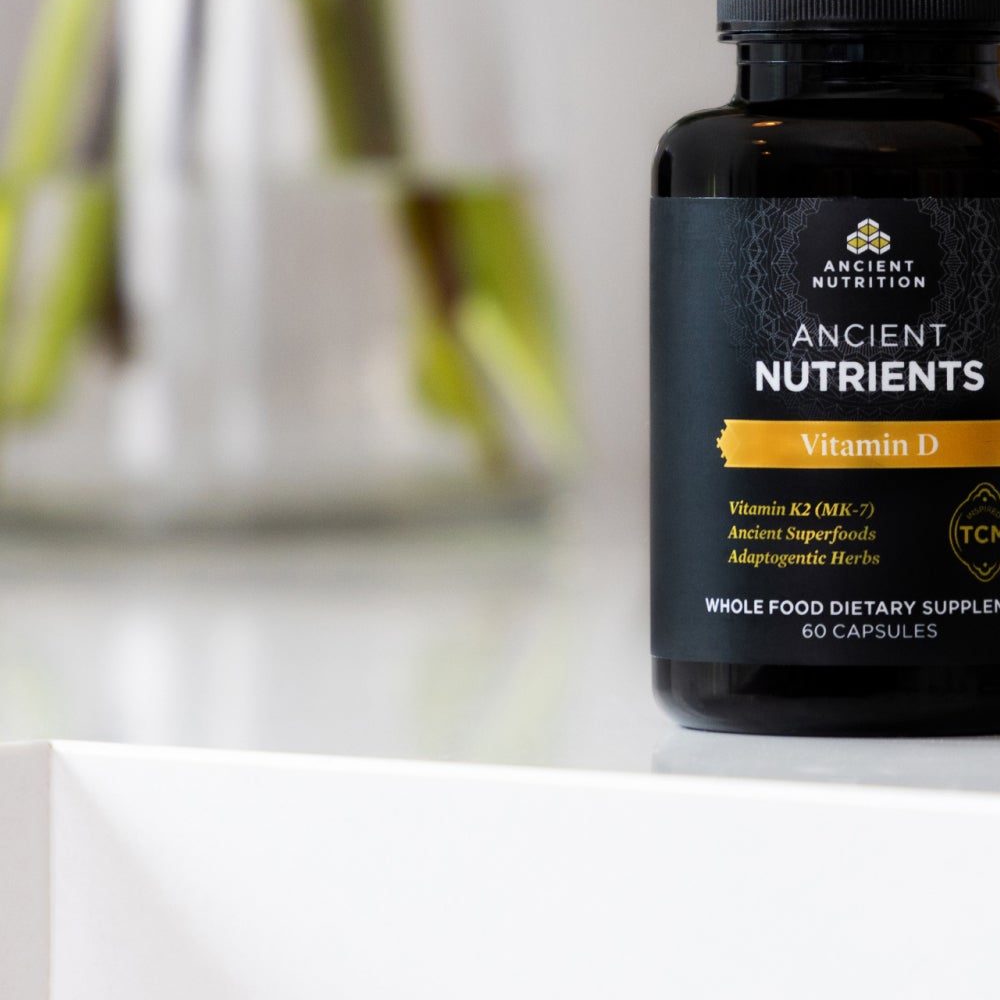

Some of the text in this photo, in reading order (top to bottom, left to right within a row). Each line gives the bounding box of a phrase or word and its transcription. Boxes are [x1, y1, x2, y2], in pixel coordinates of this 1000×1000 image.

[823, 260, 914, 273] ANCIENT
[812, 276, 925, 289] NUTRITION
[791, 322, 947, 349] ANCIENT
[755, 359, 985, 393] NUTRIENTS
[800, 432, 940, 457] Vitamin D
[728, 499, 876, 519] Vitamin K2 (MK-7)
[727, 524, 877, 545] Ancient Superfoods
[727, 548, 881, 569] Adaptogentic Herbs
[704, 597, 765, 616] WHOLE
[768, 599, 825, 616] FOOD
[829, 599, 917, 617] DIETARY
[801, 622, 938, 640] 60 CAPSULES
